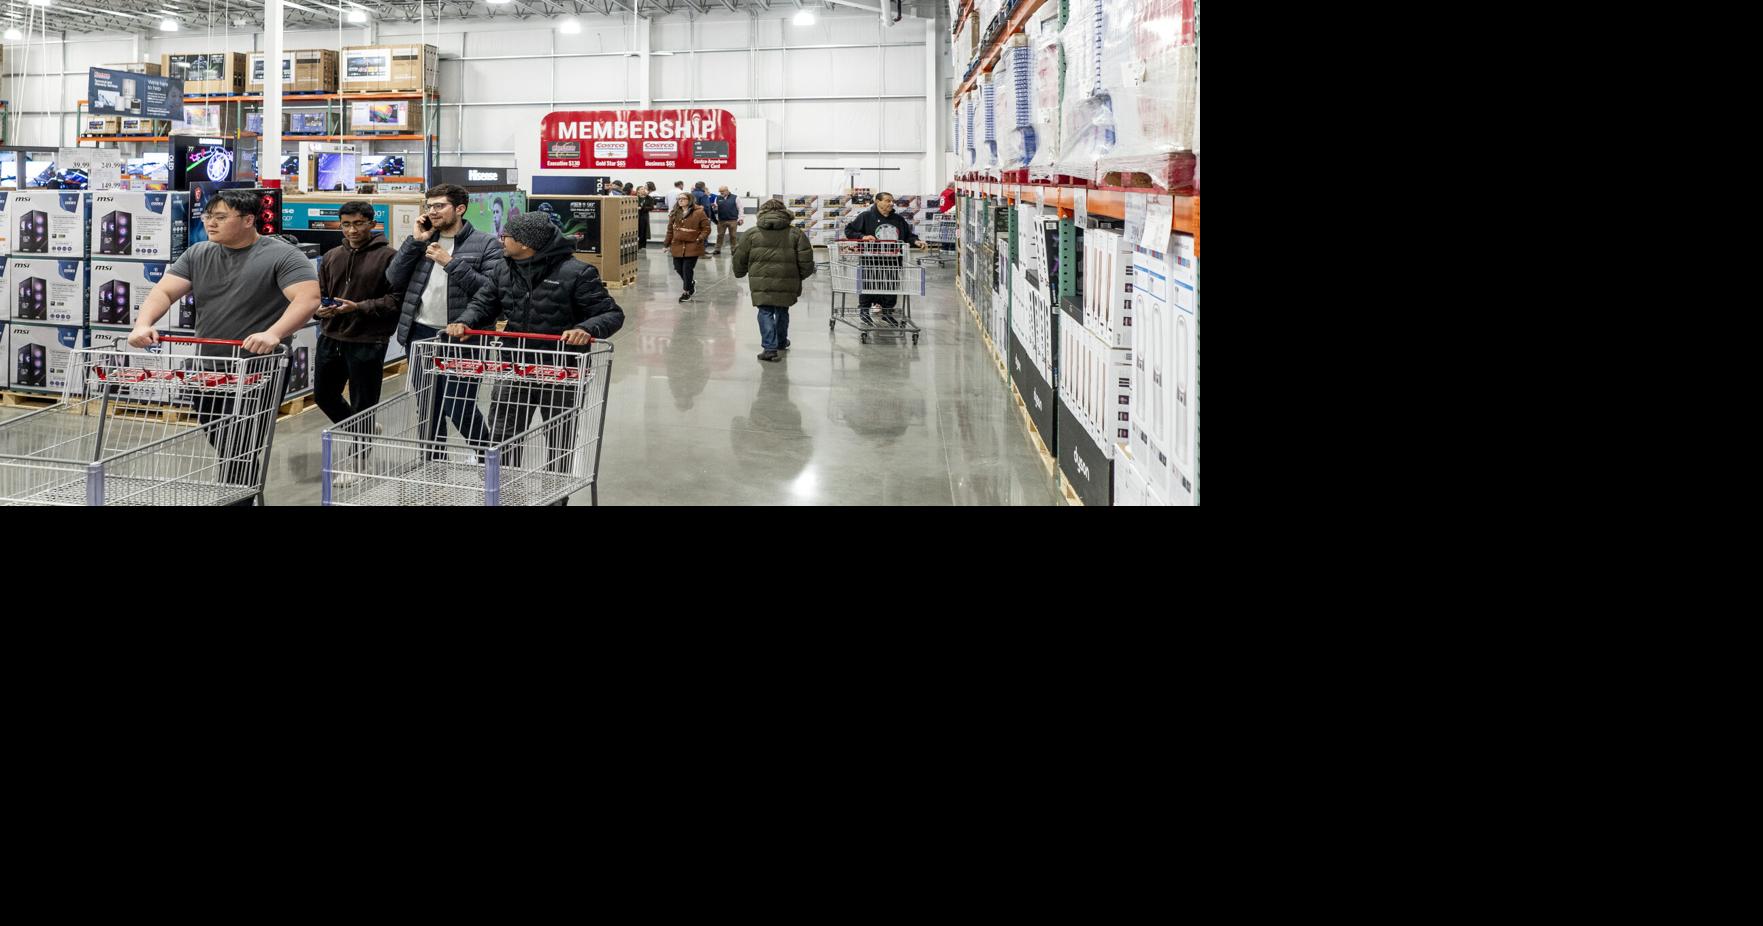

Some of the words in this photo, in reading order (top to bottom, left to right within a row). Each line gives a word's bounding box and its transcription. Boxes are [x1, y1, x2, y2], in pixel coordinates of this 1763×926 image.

[558, 121, 716, 139] MEMBERSHIP
[468, 169, 498, 181] Hisense
[1073, 446, 1090, 481] dyson
